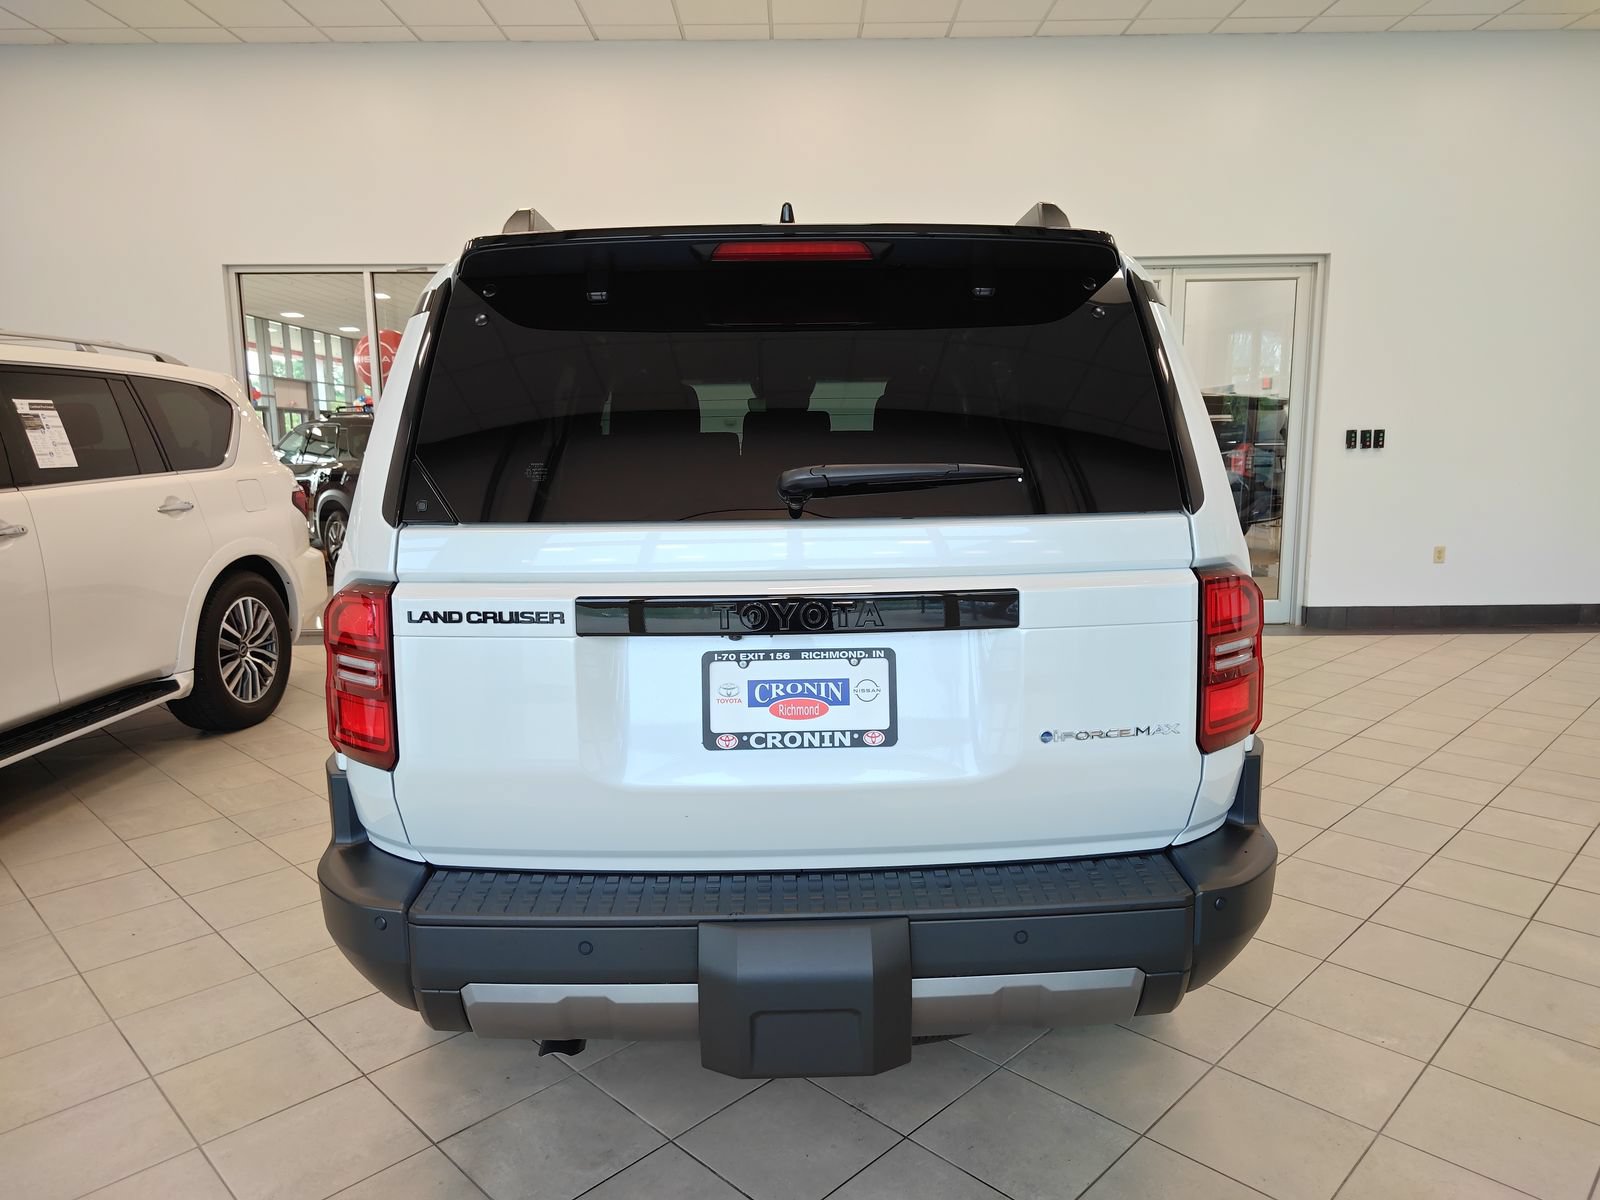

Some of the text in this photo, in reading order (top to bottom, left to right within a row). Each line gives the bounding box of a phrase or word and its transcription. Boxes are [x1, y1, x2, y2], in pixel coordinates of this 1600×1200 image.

[407, 611, 565, 624] LAND CRUISER
[712, 601, 884, 631] TOYOTA
[714, 650, 885, 661] I-70 EXIT 156 RICHMOND, IN
[754, 682, 843, 703] CRONIN
[778, 703, 820, 717] Richmond
[749, 731, 851, 749] CRONIN
